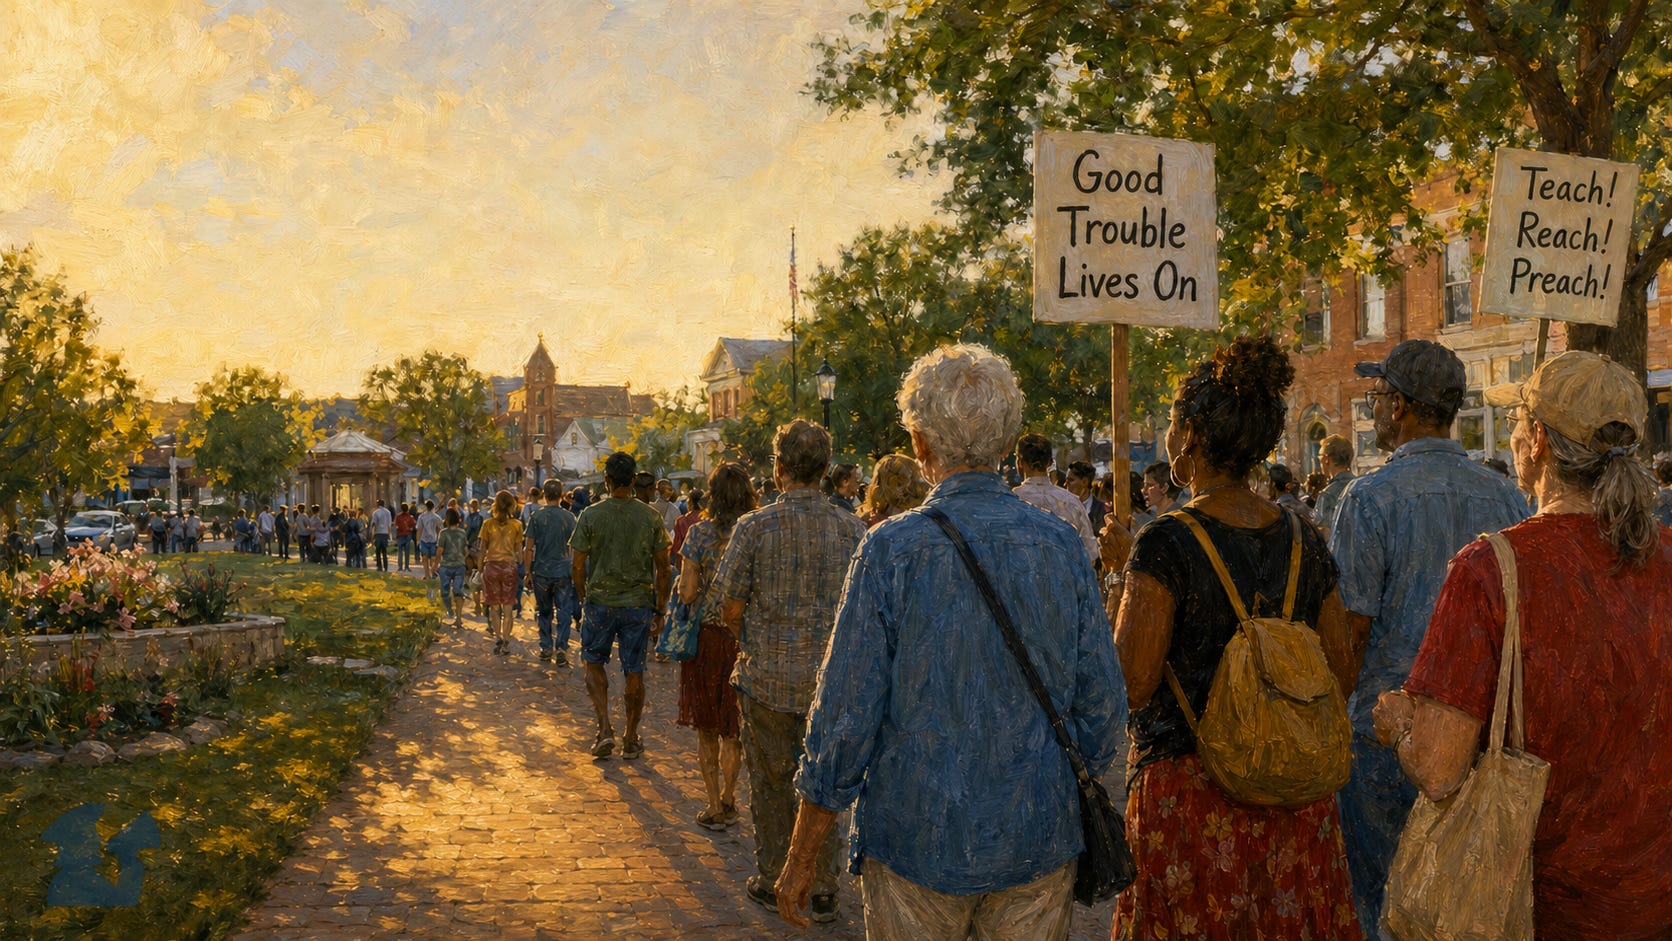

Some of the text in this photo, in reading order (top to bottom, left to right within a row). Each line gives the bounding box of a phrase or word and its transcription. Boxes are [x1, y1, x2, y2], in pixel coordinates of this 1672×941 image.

[1072, 149, 1164, 196] Good
[1520, 166, 1618, 208] Teach!
[1056, 205, 1186, 249] Trouble
[1516, 210, 1614, 255] Reach!
[1058, 255, 1198, 302] Lives On
[1509, 257, 1612, 300] Preach!
